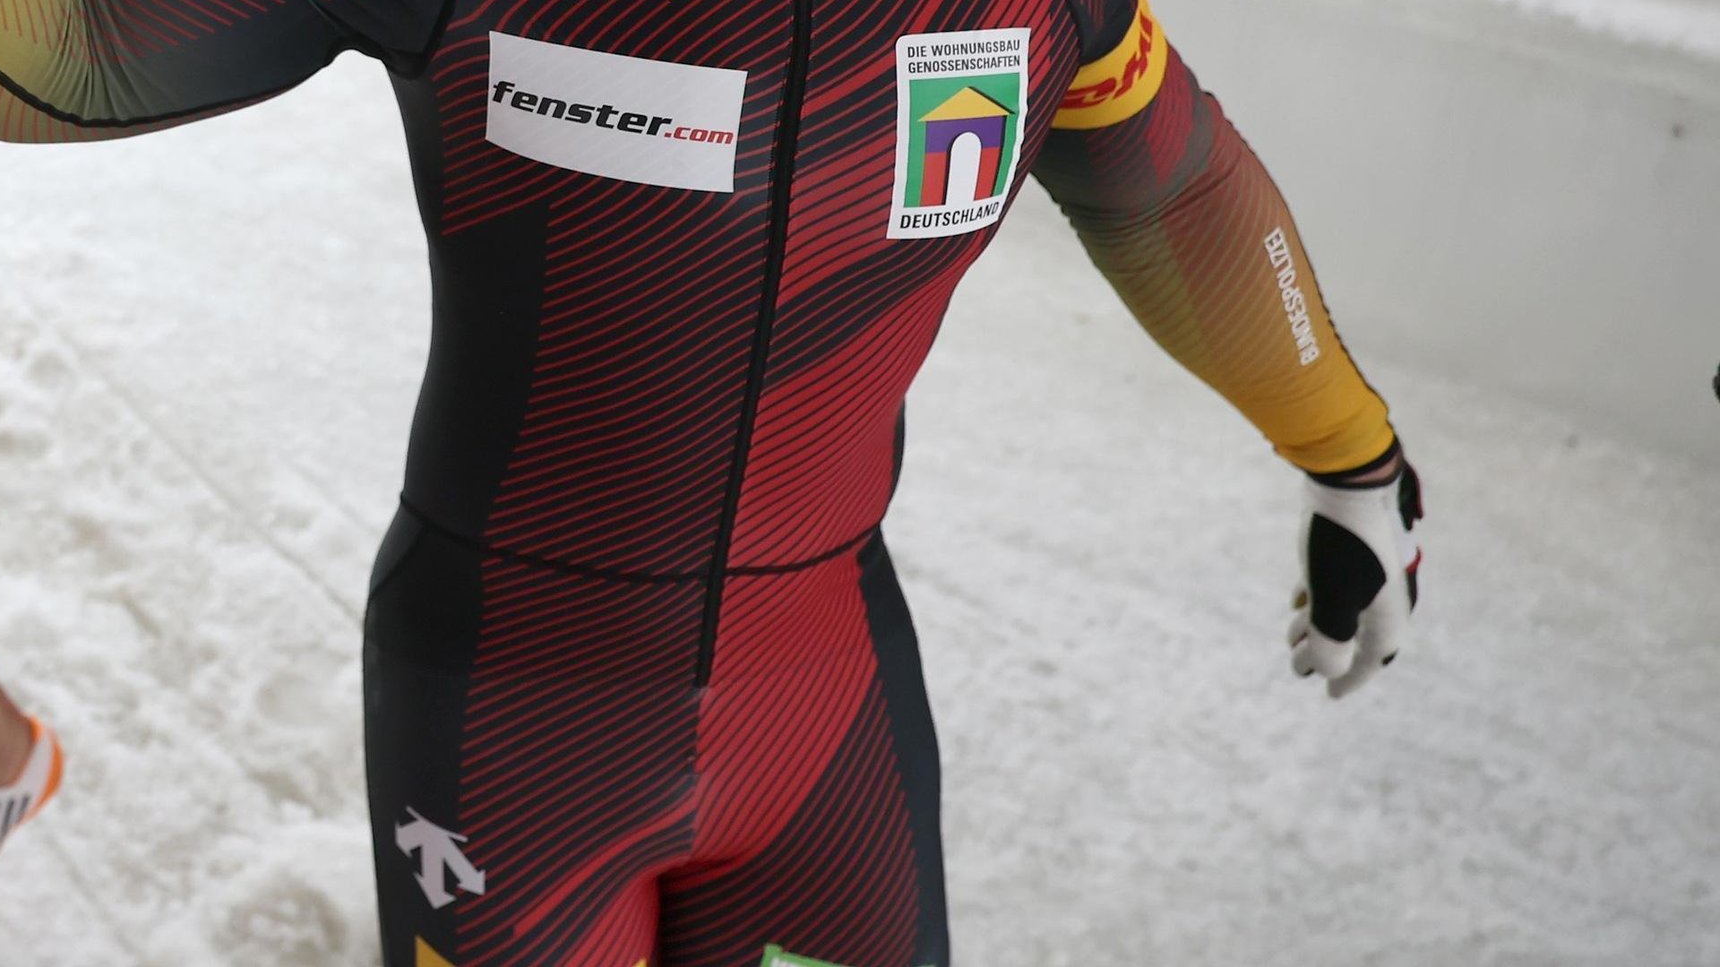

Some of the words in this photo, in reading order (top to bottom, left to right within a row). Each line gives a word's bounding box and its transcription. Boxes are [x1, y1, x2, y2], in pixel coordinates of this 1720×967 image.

[907, 45, 927, 58] DIE
[930, 39, 1020, 57] WOHNUNGSBAU
[908, 55, 1020, 74] GENOSSENSCHAFTEN
[493, 81, 734, 144] fenster.com
[899, 201, 999, 229] DEUTSCHLAND
[1264, 227, 1320, 366] BUNDESPOLIZEI
